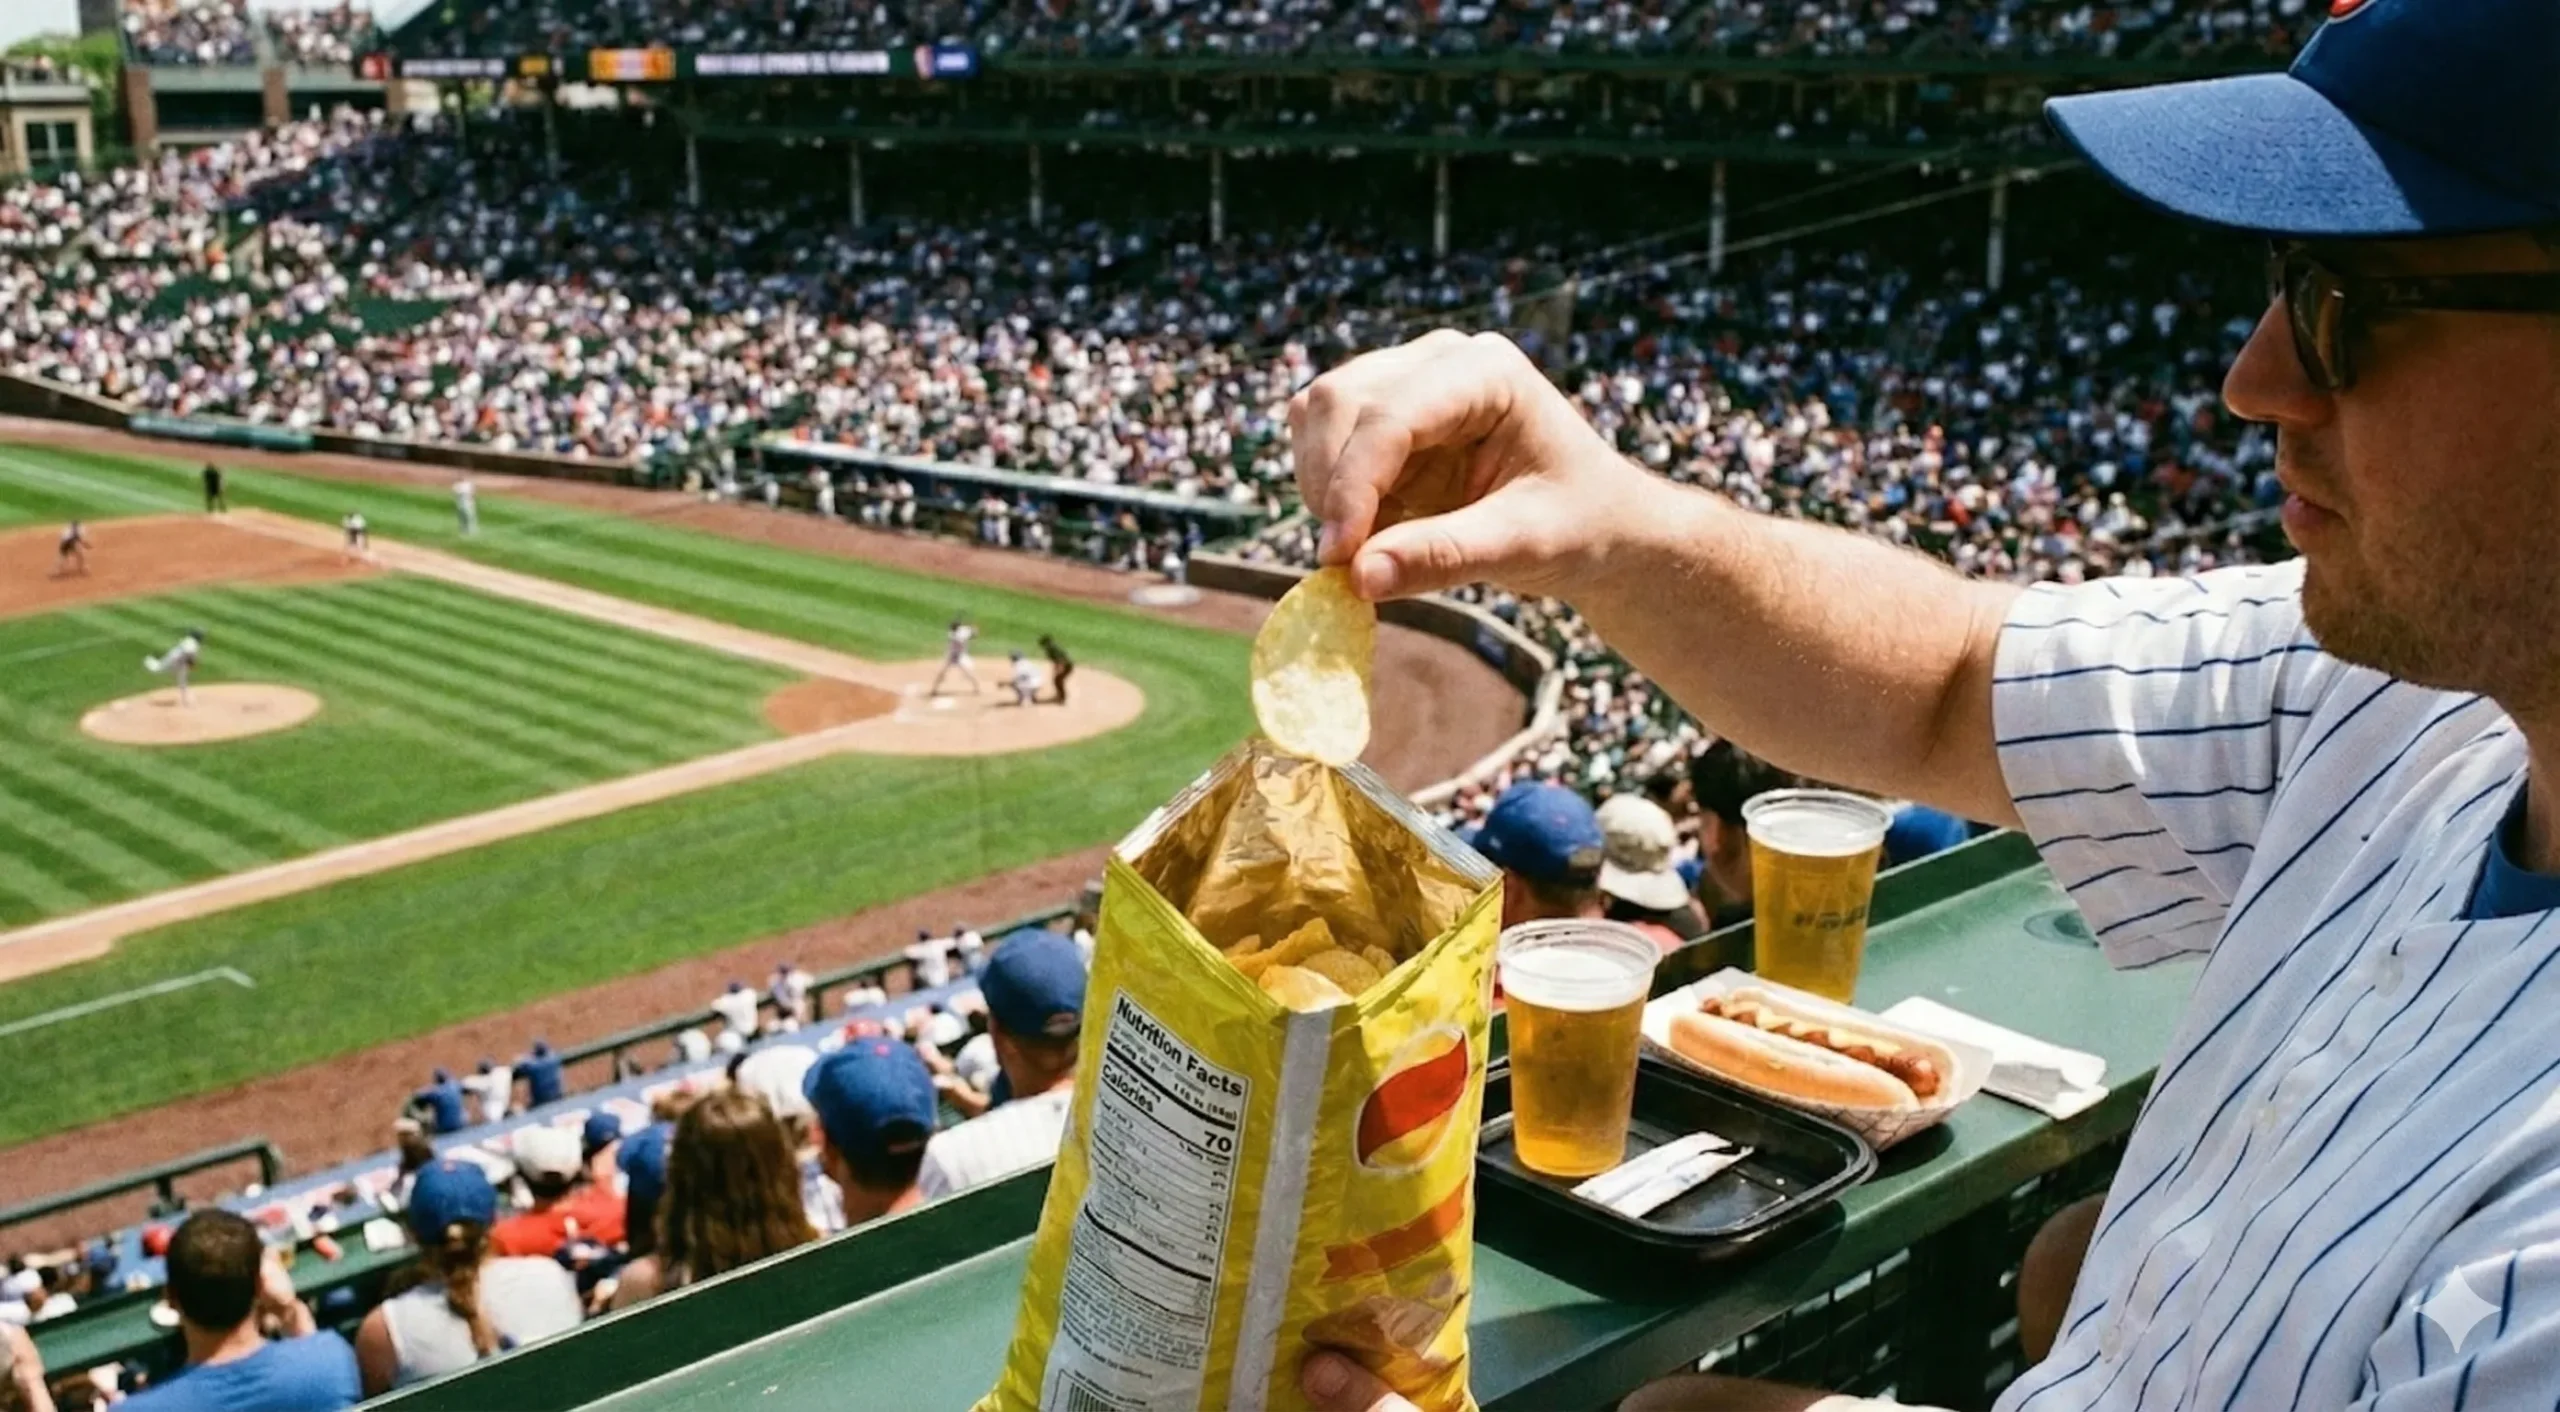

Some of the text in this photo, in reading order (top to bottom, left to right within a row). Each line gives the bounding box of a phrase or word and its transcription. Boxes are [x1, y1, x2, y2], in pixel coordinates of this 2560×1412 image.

[1116, 997, 1181, 1064] Nutrition
[1187, 1054, 1242, 1096] Facts
[1102, 1064, 1153, 1112] Calories
[1204, 1130, 1232, 1152] 70
